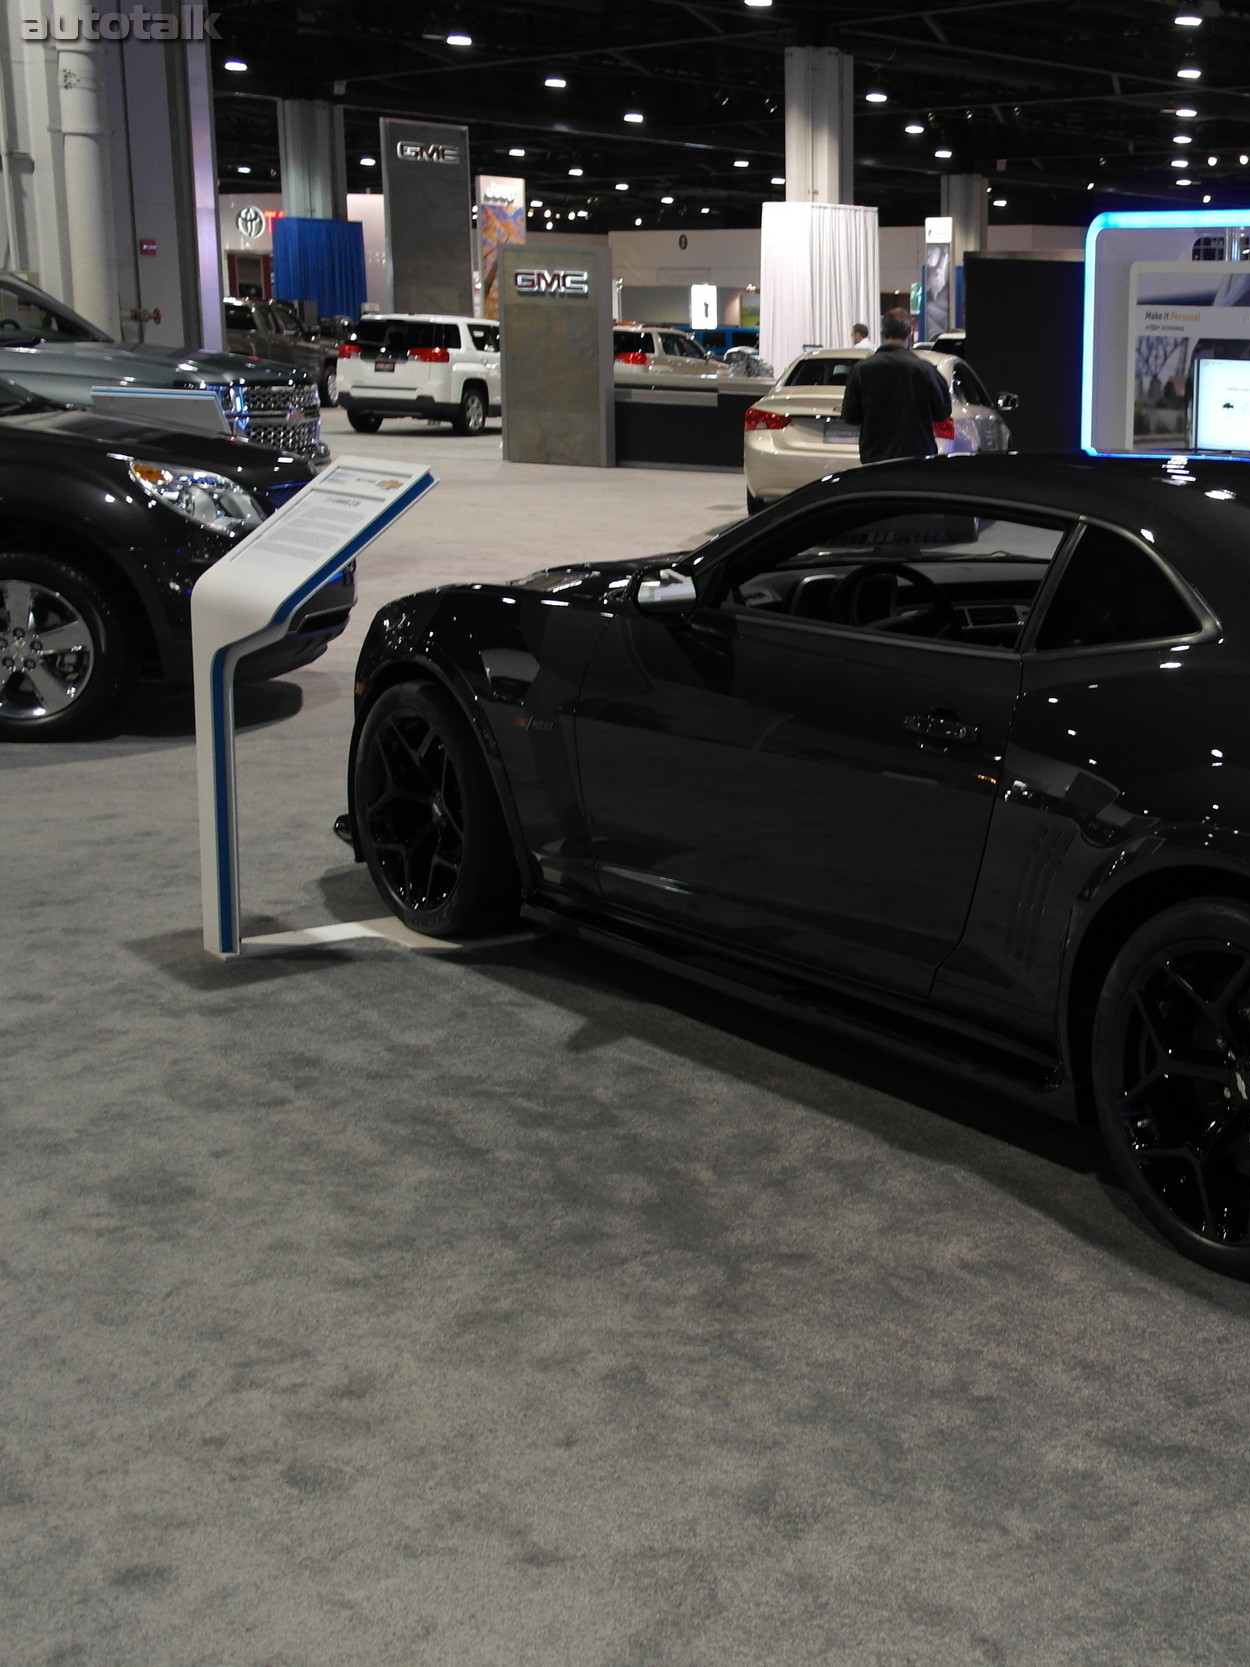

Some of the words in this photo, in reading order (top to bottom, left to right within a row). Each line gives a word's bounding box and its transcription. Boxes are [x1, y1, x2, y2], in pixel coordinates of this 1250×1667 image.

[397, 141, 460, 164] GMC
[485, 182, 517, 201] Jeep
[515, 269, 588, 293] GMC
[1170, 312, 1201, 322] Personal
